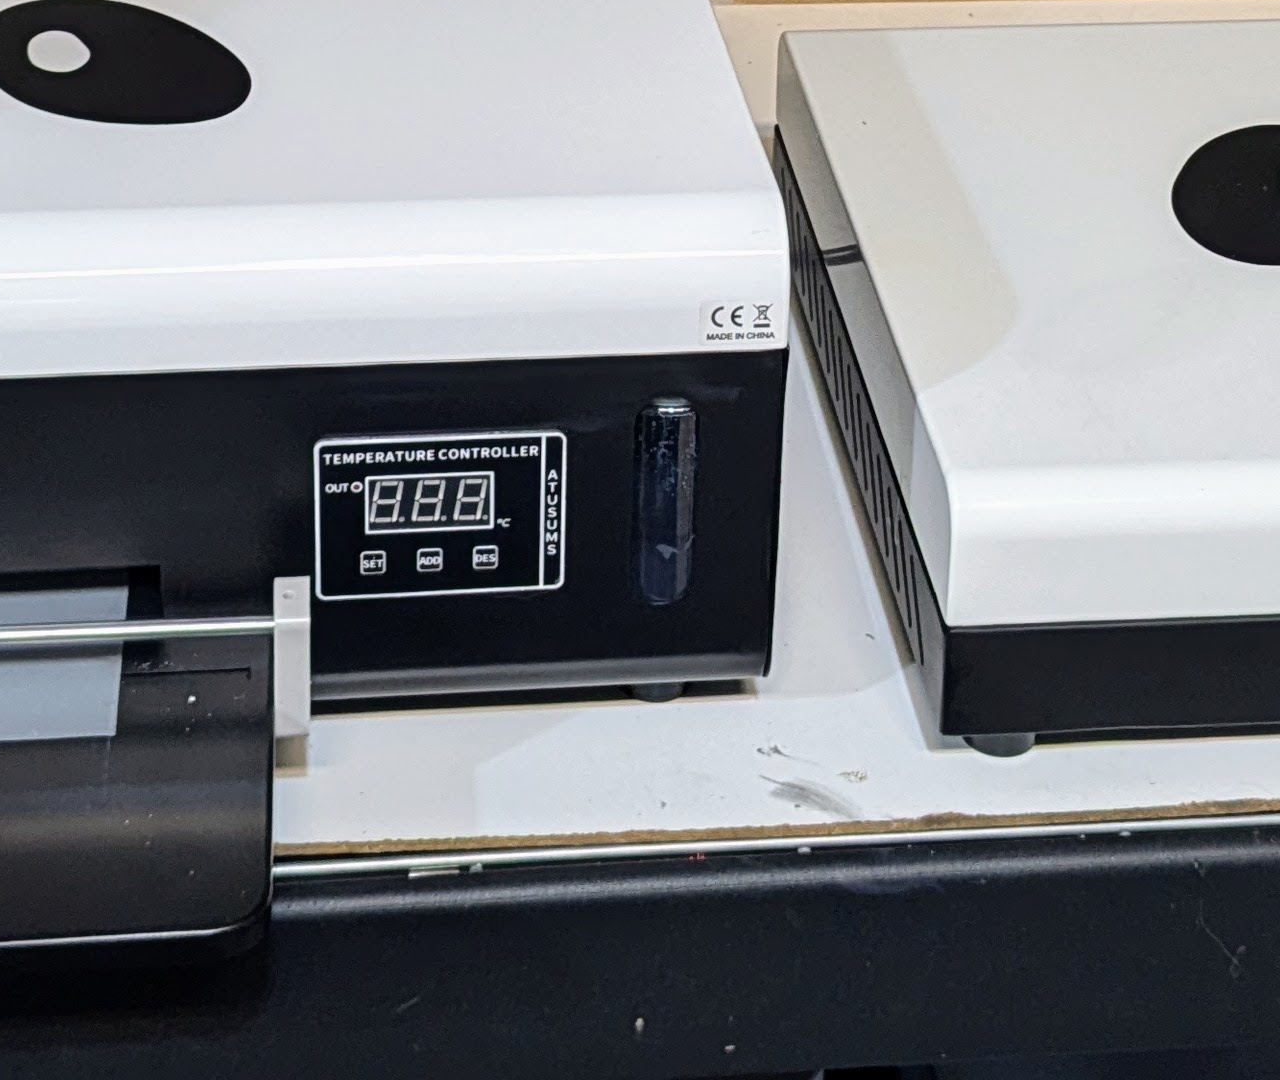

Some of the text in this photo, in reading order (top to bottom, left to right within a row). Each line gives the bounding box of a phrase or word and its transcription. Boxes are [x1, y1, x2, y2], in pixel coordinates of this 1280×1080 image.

[706, 331, 775, 341] MADE IN CHINA
[323, 445, 539, 466] TEMPERATURE CONTROLLER
[325, 483, 349, 494] OUT
[546, 469, 559, 556] ATUSUMS
[363, 558, 384, 569] SET
[419, 556, 442, 566] ADD
[475, 553, 497, 563] DES
